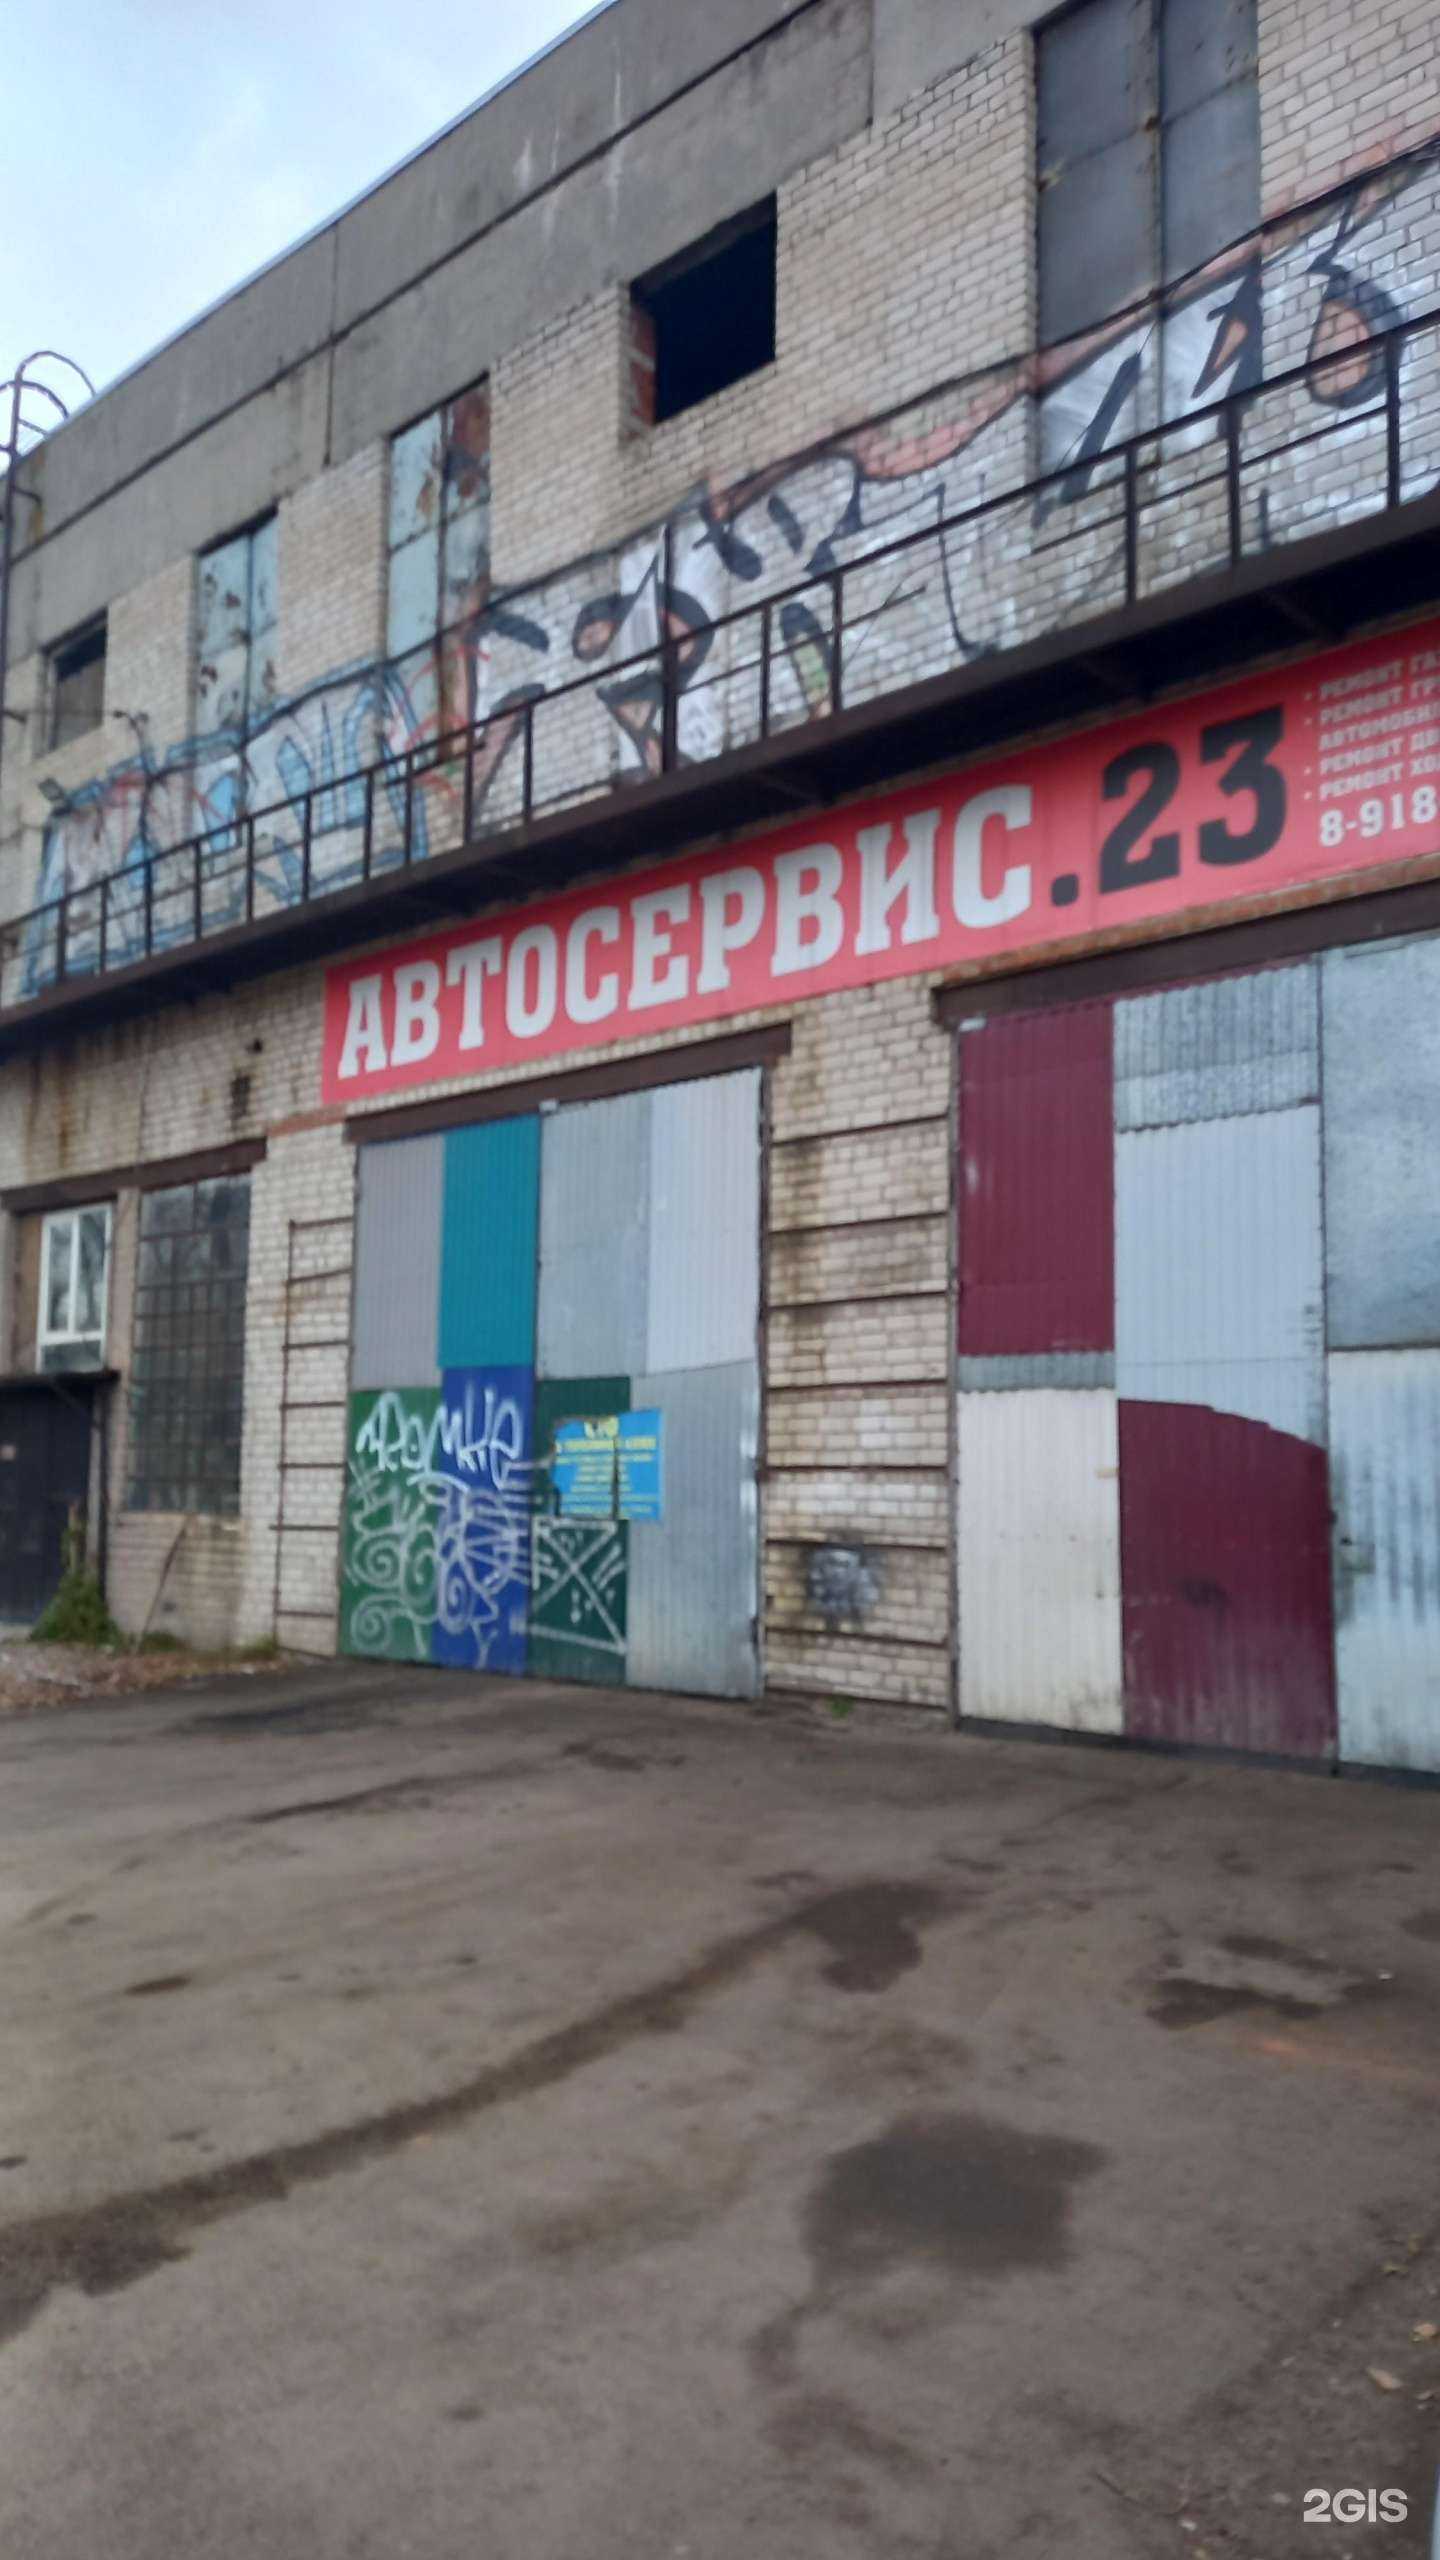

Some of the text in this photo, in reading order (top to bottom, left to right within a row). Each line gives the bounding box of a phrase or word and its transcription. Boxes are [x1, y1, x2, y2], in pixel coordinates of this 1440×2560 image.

[1320, 660, 1404, 699] РЕМОНТ
[1320, 686, 1404, 725] РЕМОНТ
[1320, 736, 1404, 775] РЕМОНТ
[1320, 762, 1404, 801] РЕМОНТ
[1319, 784, 1438, 847] 8-918
